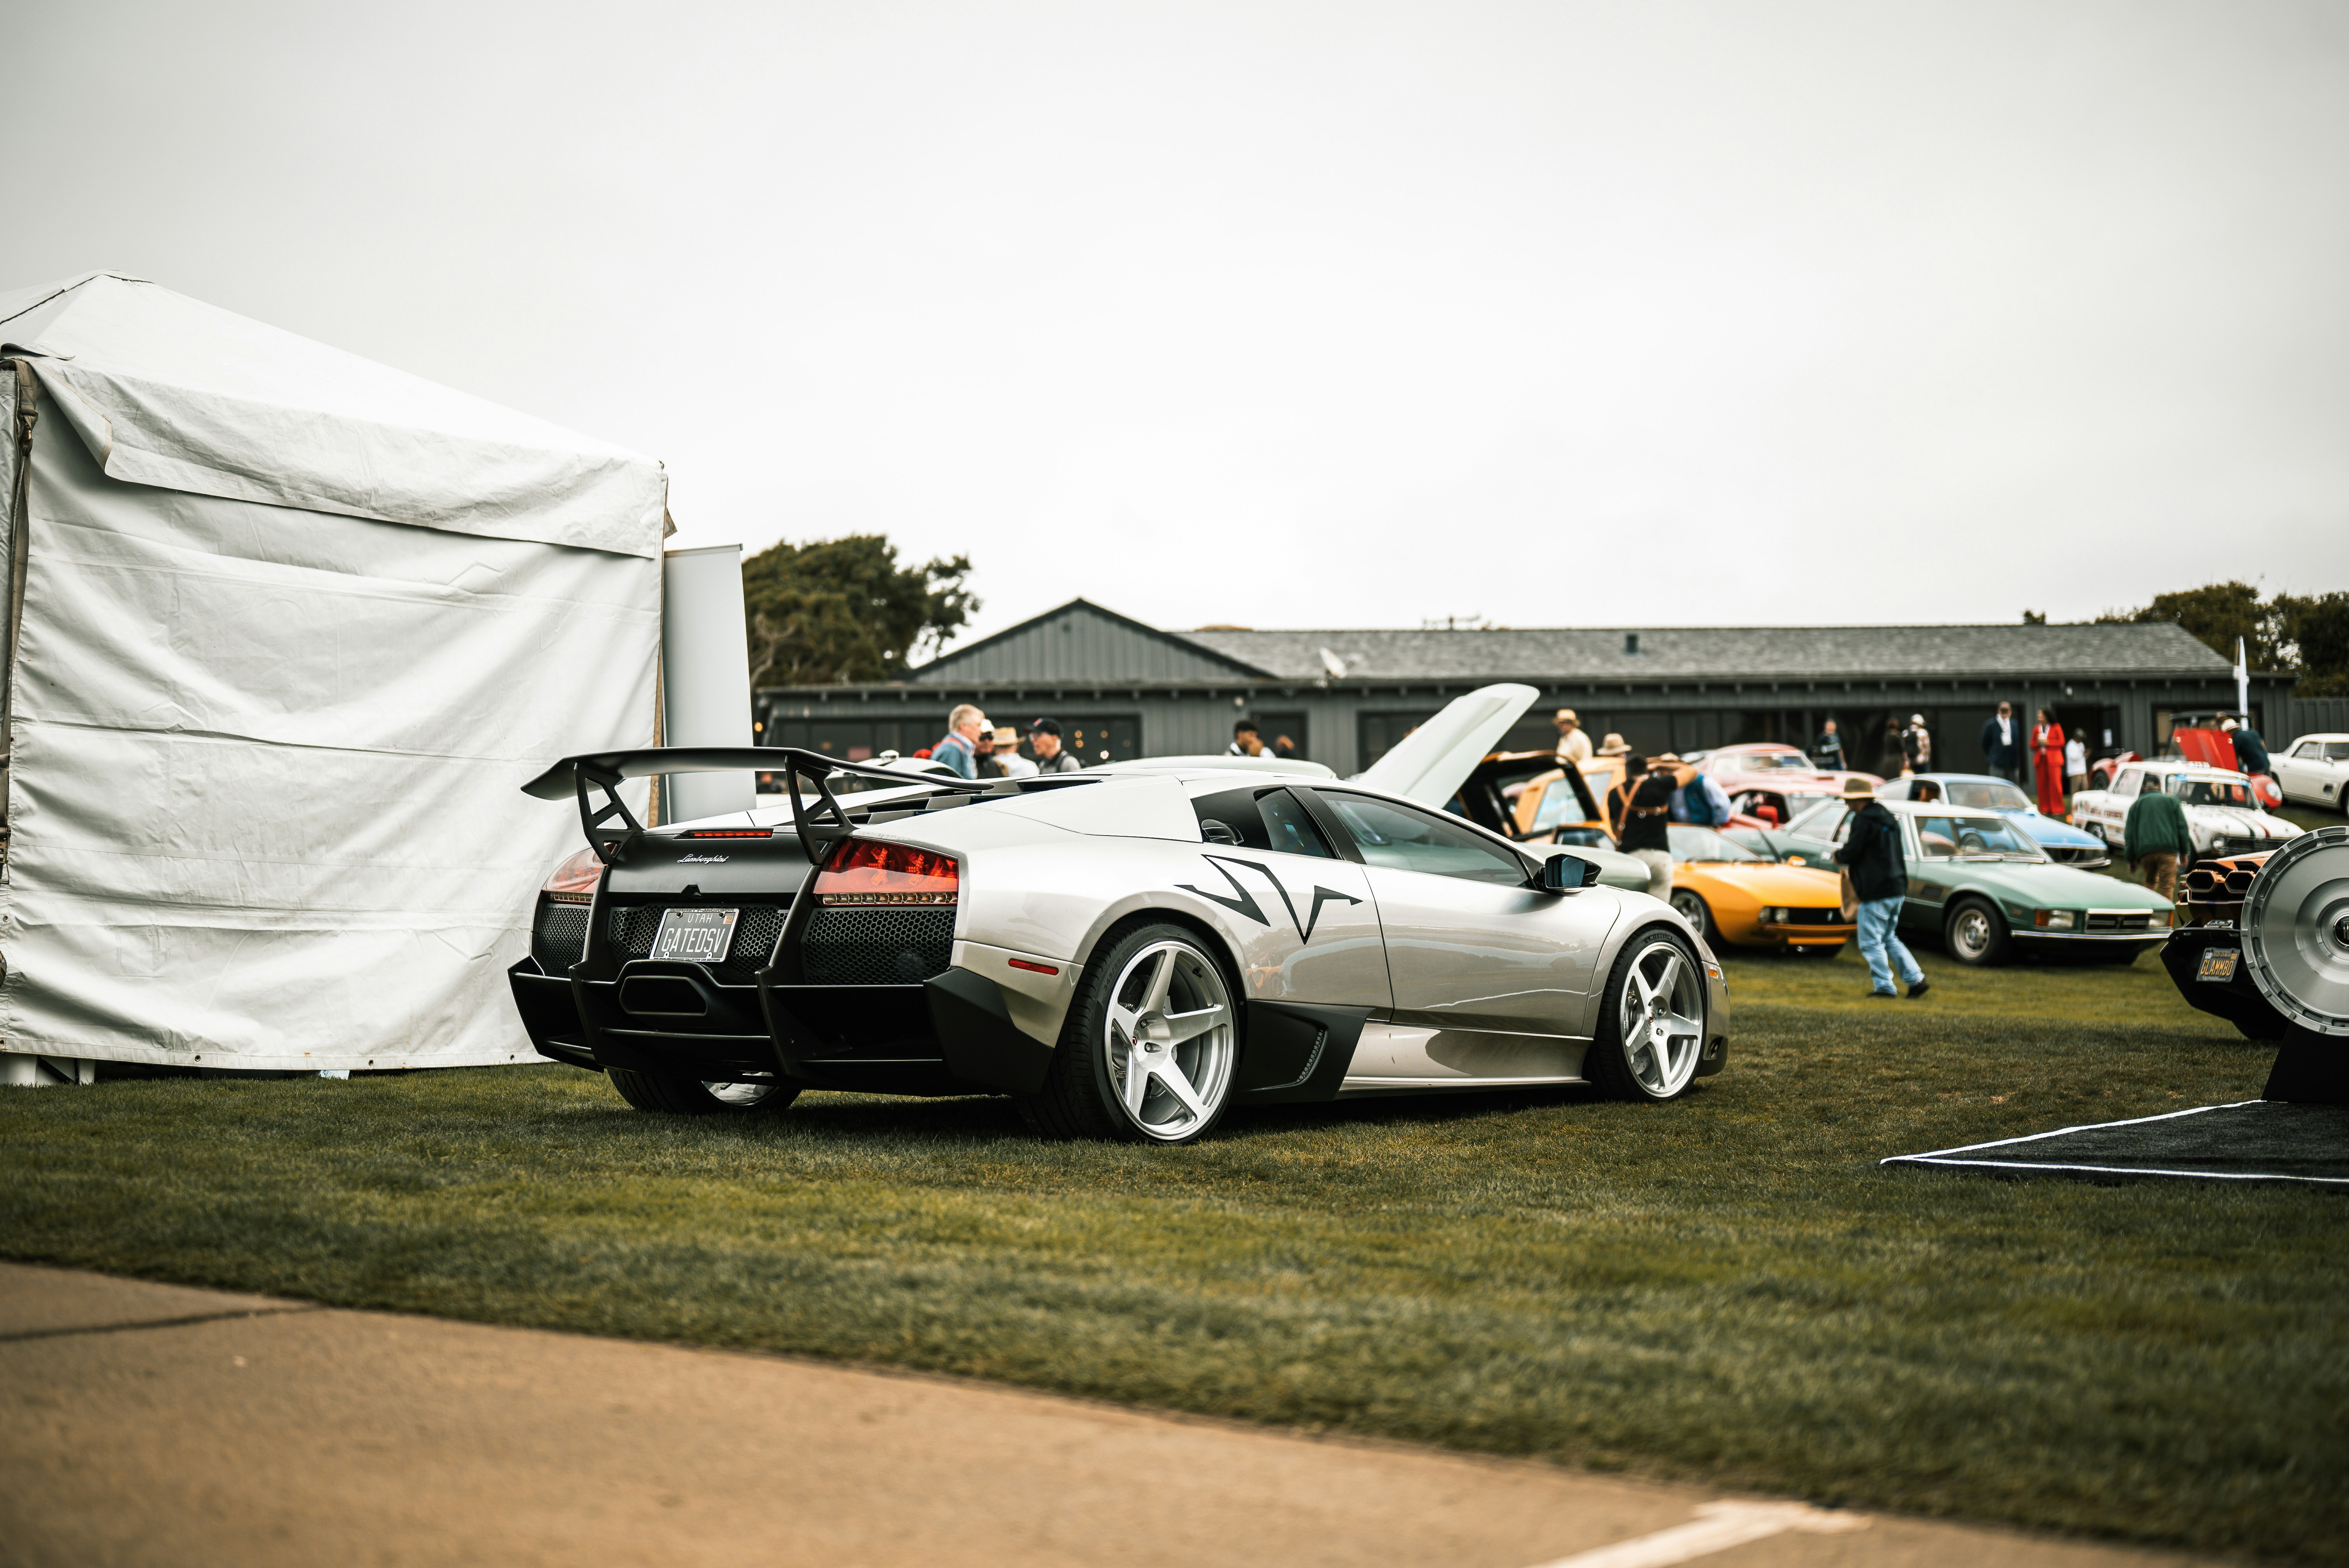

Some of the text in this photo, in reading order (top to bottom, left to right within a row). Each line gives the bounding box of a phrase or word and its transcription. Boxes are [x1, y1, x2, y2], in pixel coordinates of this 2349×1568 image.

[677, 854, 729, 864] Lamborghini
[688, 914, 713, 923] UTAH
[661, 928, 725, 953] GATEDSV
[2200, 959, 2234, 976] GLAMMBO
